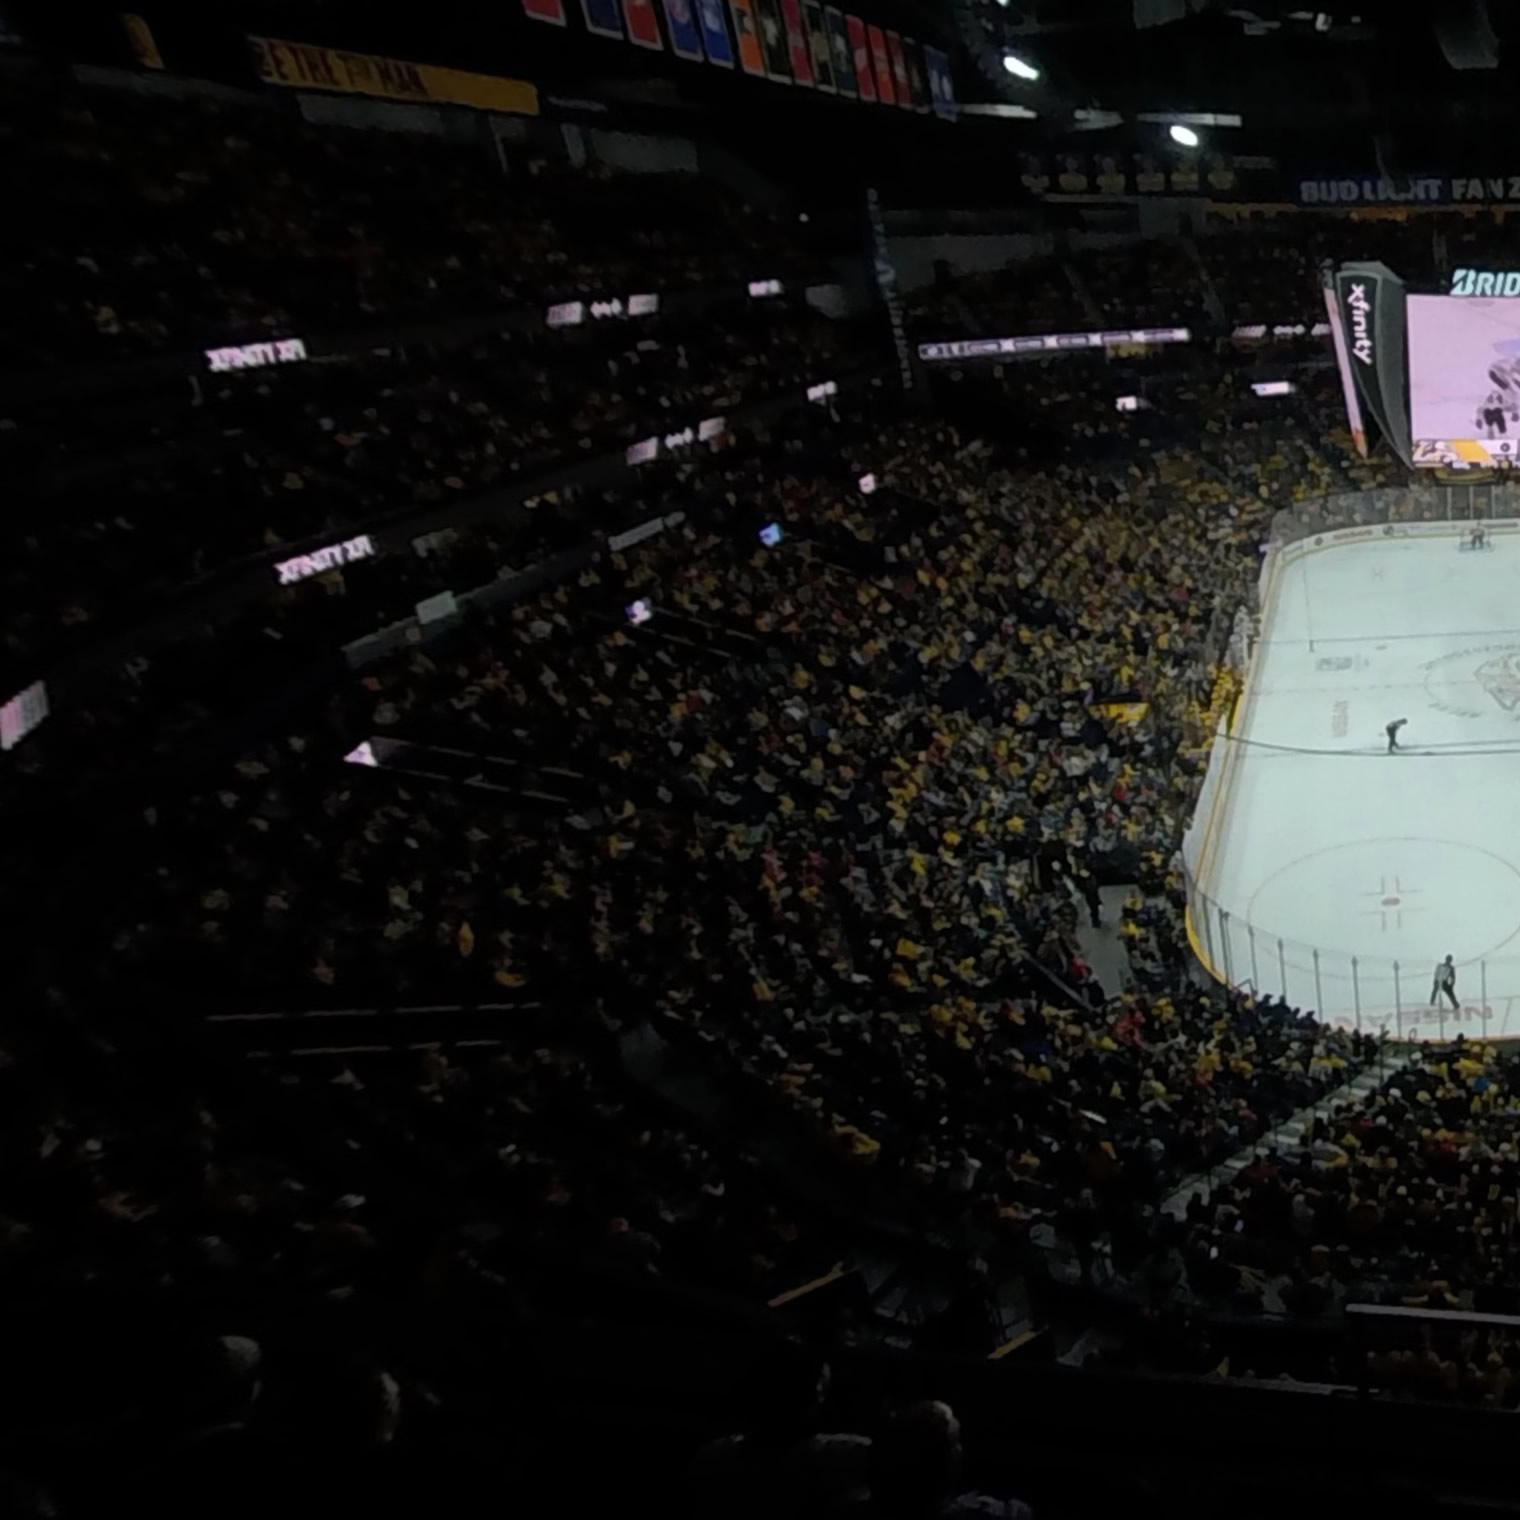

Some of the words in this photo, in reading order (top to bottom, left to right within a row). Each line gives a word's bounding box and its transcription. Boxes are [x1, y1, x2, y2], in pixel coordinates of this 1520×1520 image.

[1299, 179, 1358, 203] BUD
[1451, 178, 1505, 201] FAN
[1347, 283, 1374, 365] xfinity
